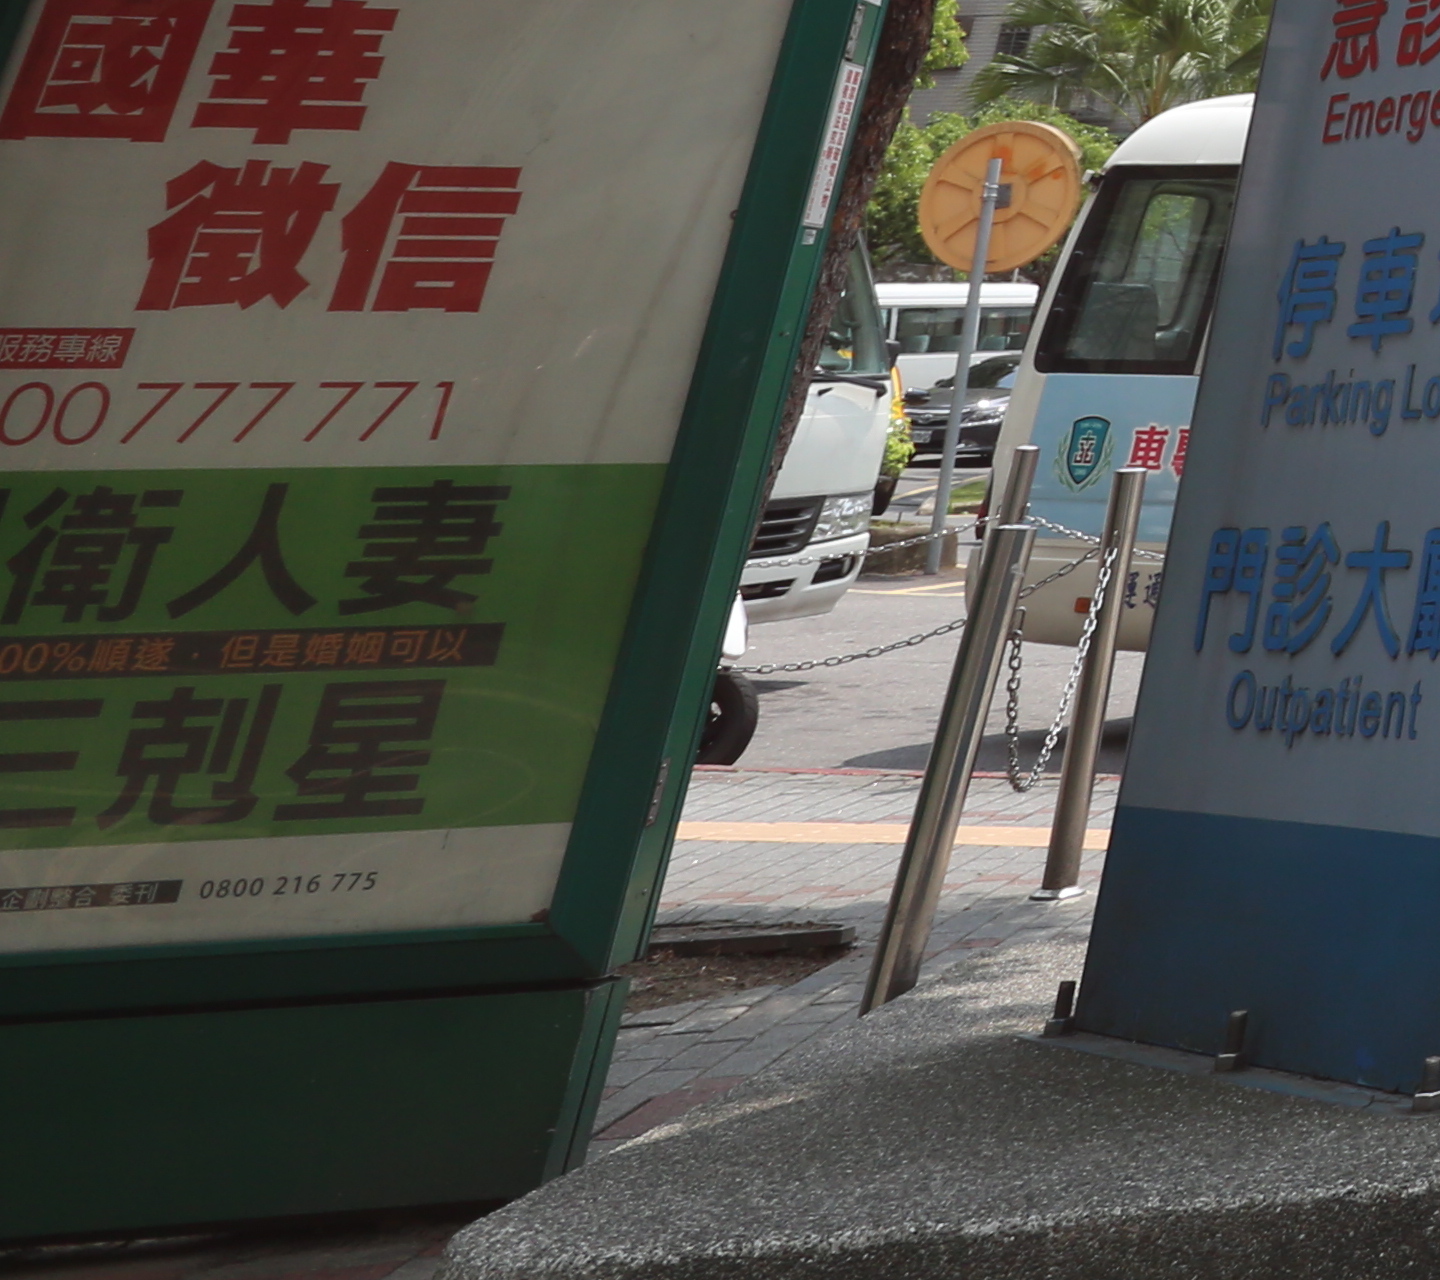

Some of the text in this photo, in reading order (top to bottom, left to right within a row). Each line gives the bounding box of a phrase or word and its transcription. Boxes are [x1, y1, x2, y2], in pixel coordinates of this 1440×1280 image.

[136, 159, 523, 313] 徵信
[1261, 368, 1396, 436] Parking
[0, 479, 511, 625] 衛人妻
[1226, 669, 1422, 750] Outpatient
[199, 870, 378, 900] 0800 216 775
